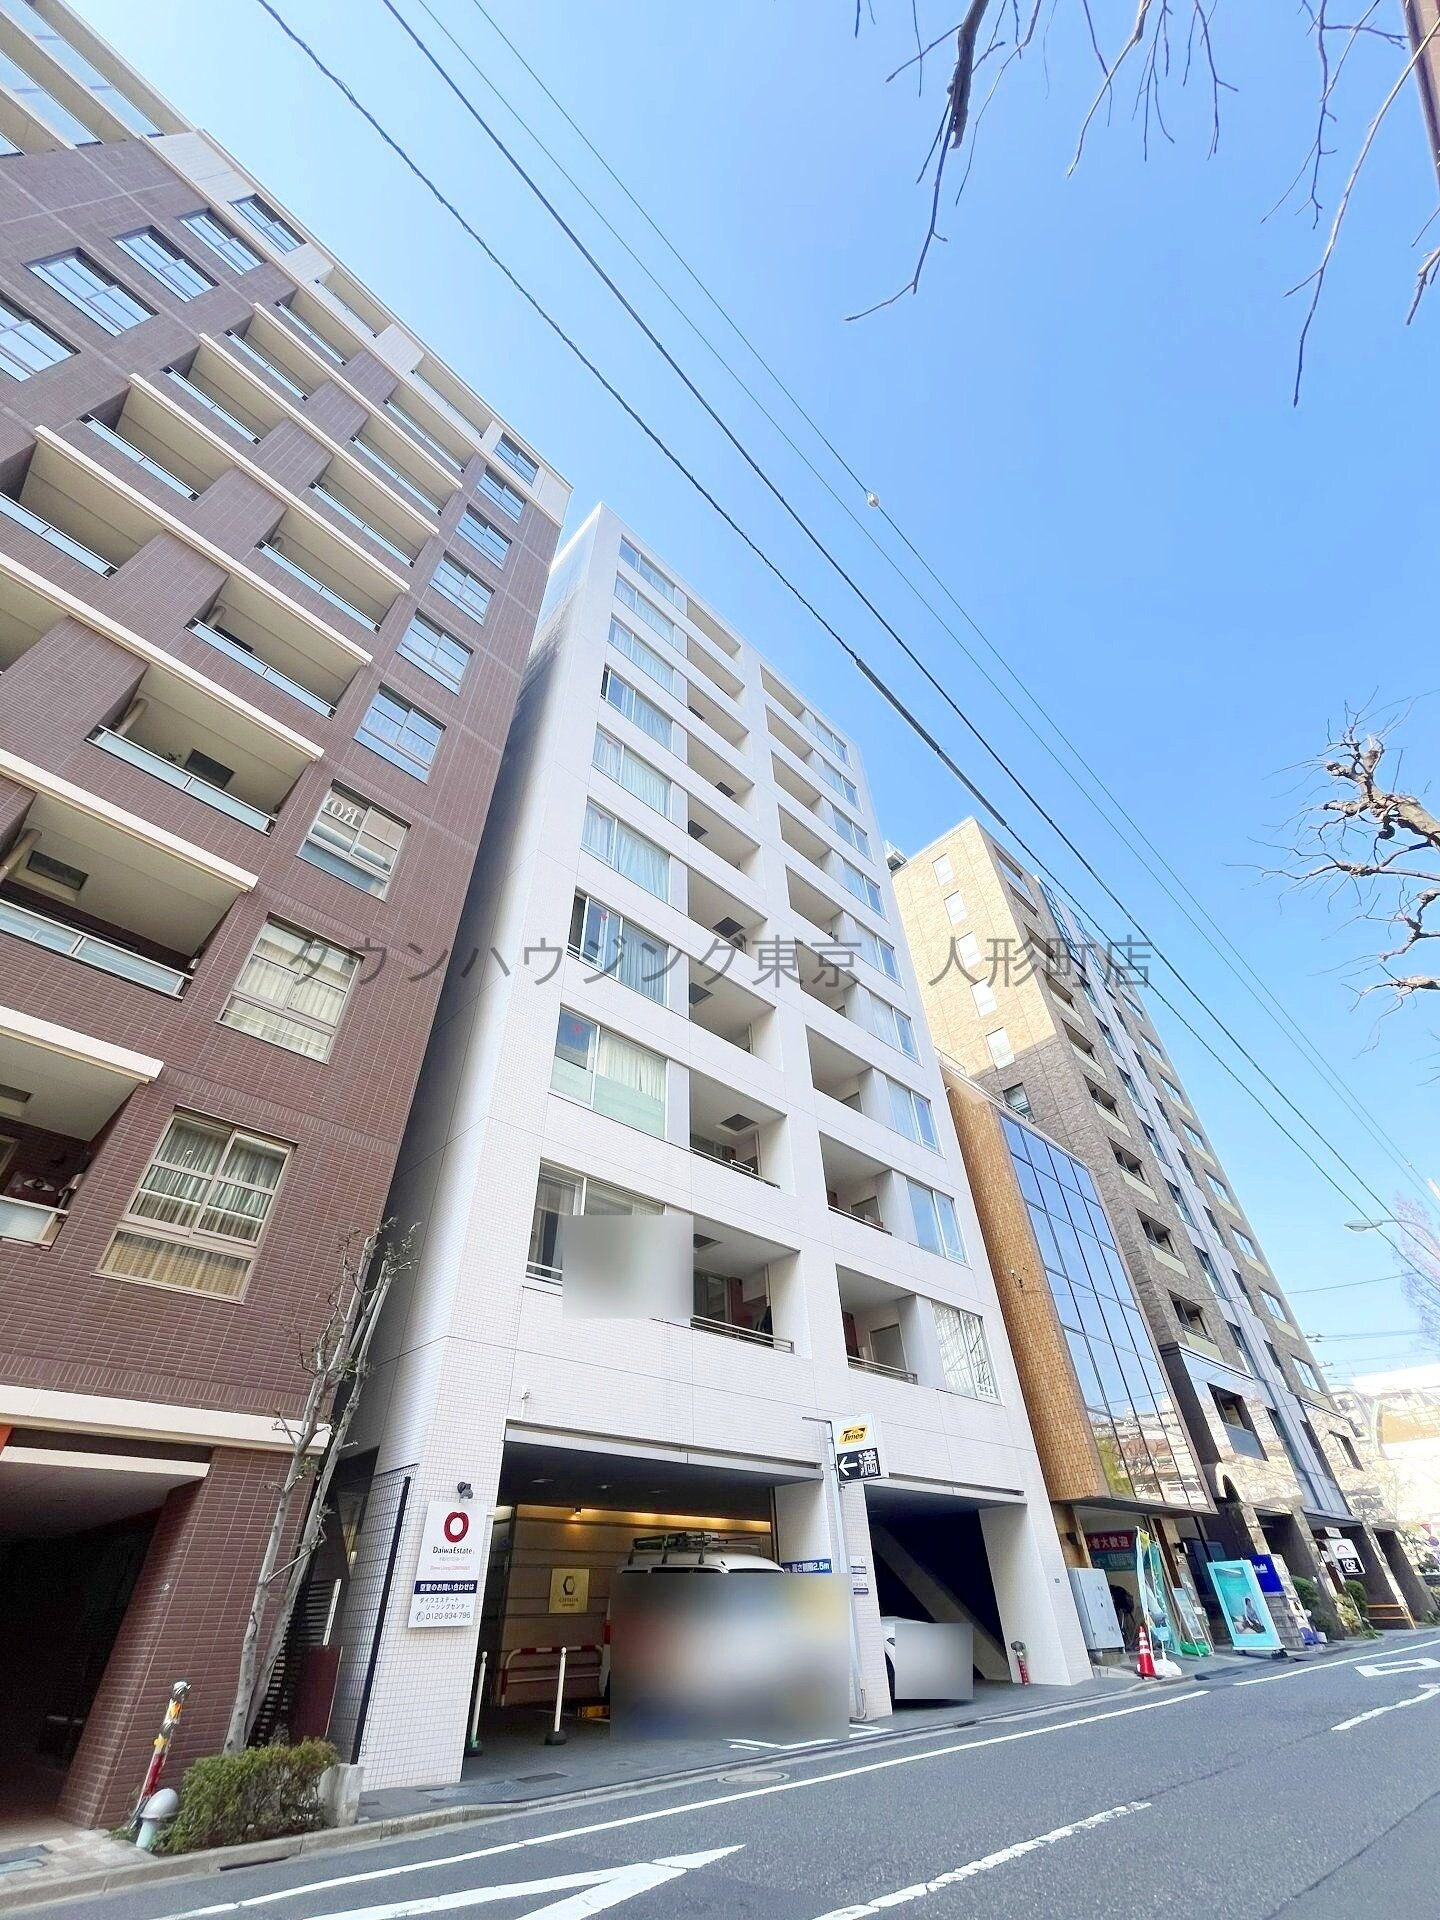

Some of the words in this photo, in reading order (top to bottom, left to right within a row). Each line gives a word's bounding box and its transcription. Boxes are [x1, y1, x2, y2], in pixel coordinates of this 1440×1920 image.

[843, 1431, 865, 1442] Times
[858, 1450, 879, 1476] 満
[1087, 1536, 1130, 1549] 者大歓迎
[1342, 1559, 1360, 1573] 空
